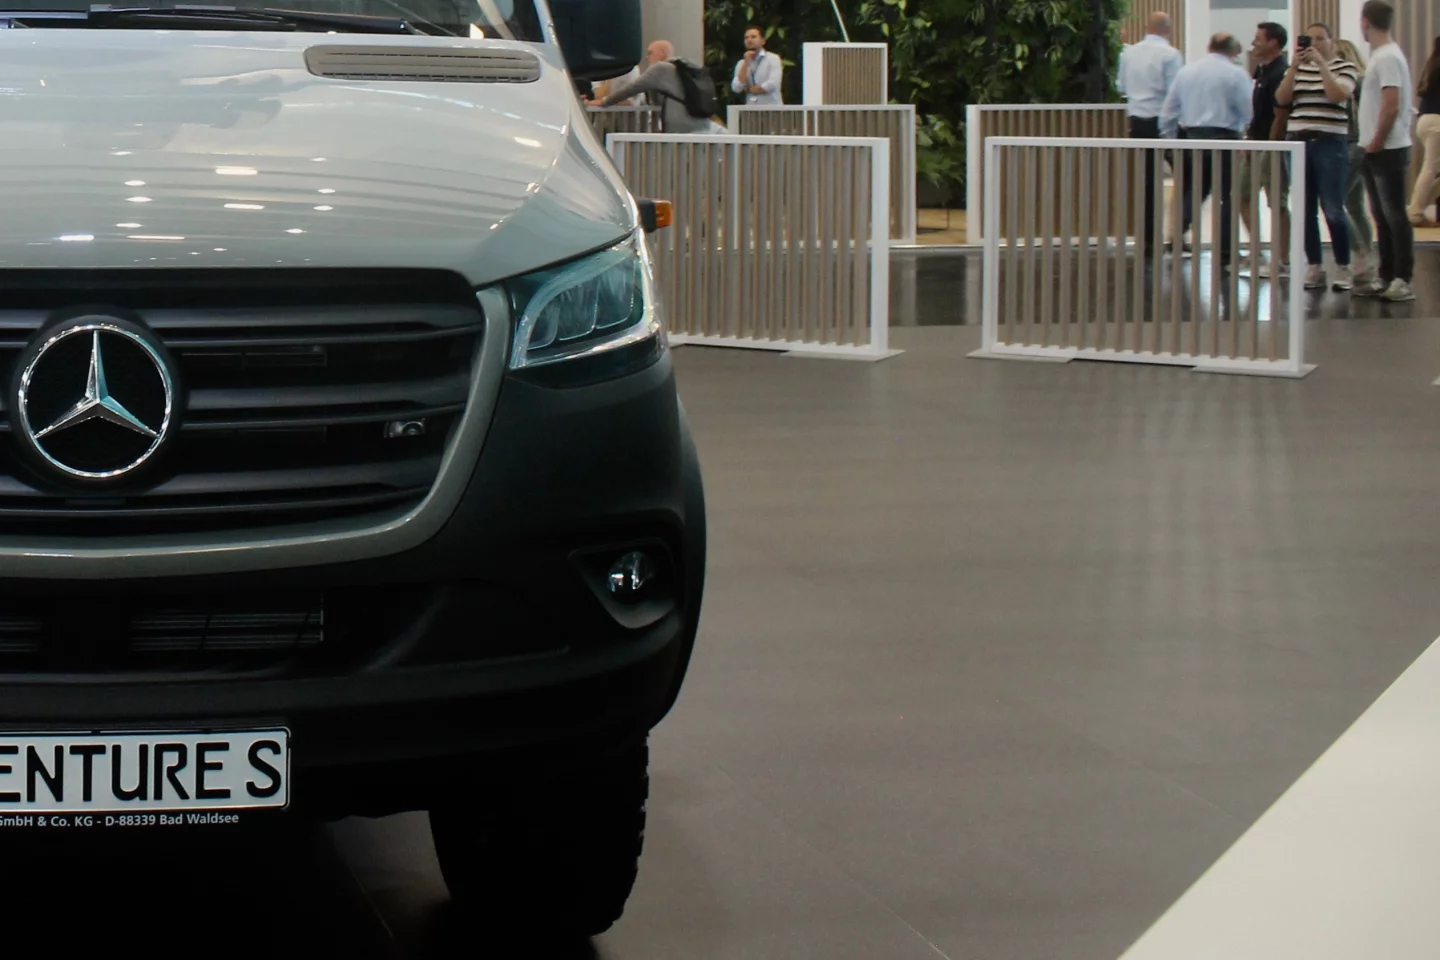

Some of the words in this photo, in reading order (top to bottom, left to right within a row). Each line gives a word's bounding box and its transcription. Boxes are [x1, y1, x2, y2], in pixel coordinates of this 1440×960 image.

[246, 740, 282, 799] S
[37, 816, 47, 827] &
[50, 815, 71, 827] Co.
[74, 815, 93, 827] KG
[105, 815, 156, 827] D-88339
[160, 814, 183, 825] Bad
[186, 813, 240, 825] Waldsee
